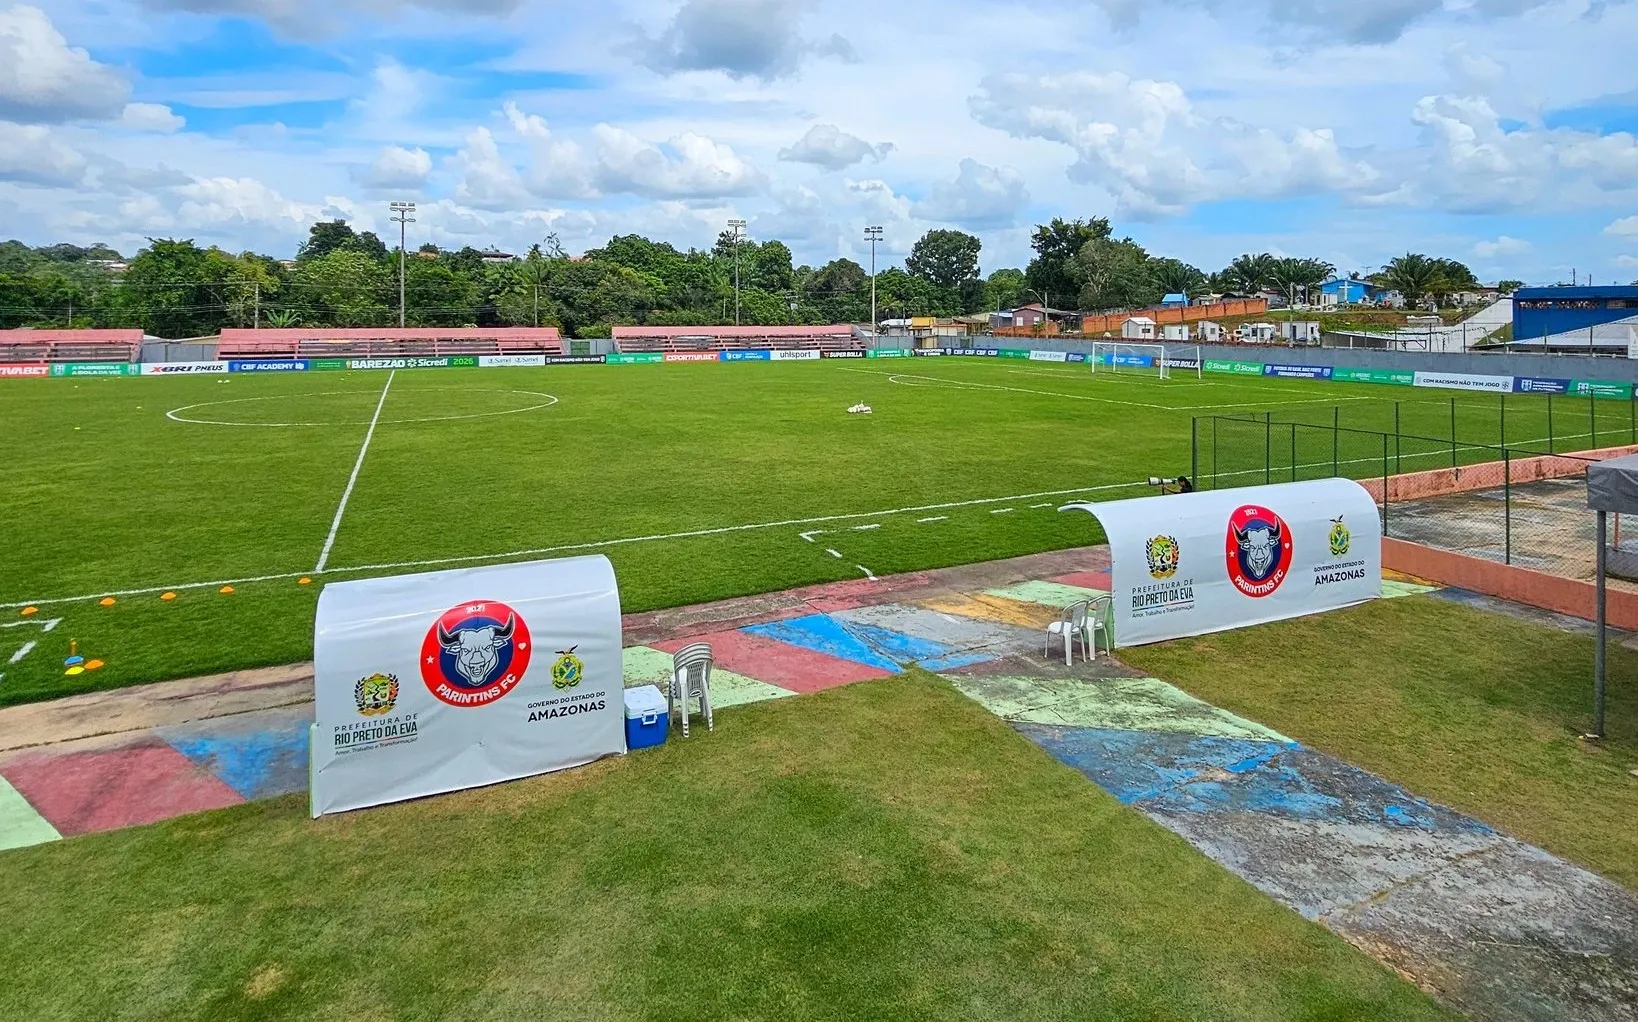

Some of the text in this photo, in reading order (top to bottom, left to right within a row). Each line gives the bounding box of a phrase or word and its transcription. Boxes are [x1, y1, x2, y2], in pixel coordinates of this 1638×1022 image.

[418, 358, 448, 367] Sicredi
[780, 350, 811, 358] uhlsport
[1235, 569, 1283, 594] PARINTINS FC
[1315, 568, 1365, 586] AMAZONAS
[1132, 581, 1180, 594] PREFEITURA
[1132, 586, 1194, 608] RIO PRETO DA EVA
[436, 674, 516, 703] PARINTINS FC
[528, 699, 559, 708] GOVERNO
[571, 693, 595, 701] ESTADO
[528, 700, 605, 722] AMAZONAS
[335, 717, 400, 732] PREFEITURA
[335, 721, 418, 745] RIO PRETO DA EVA
